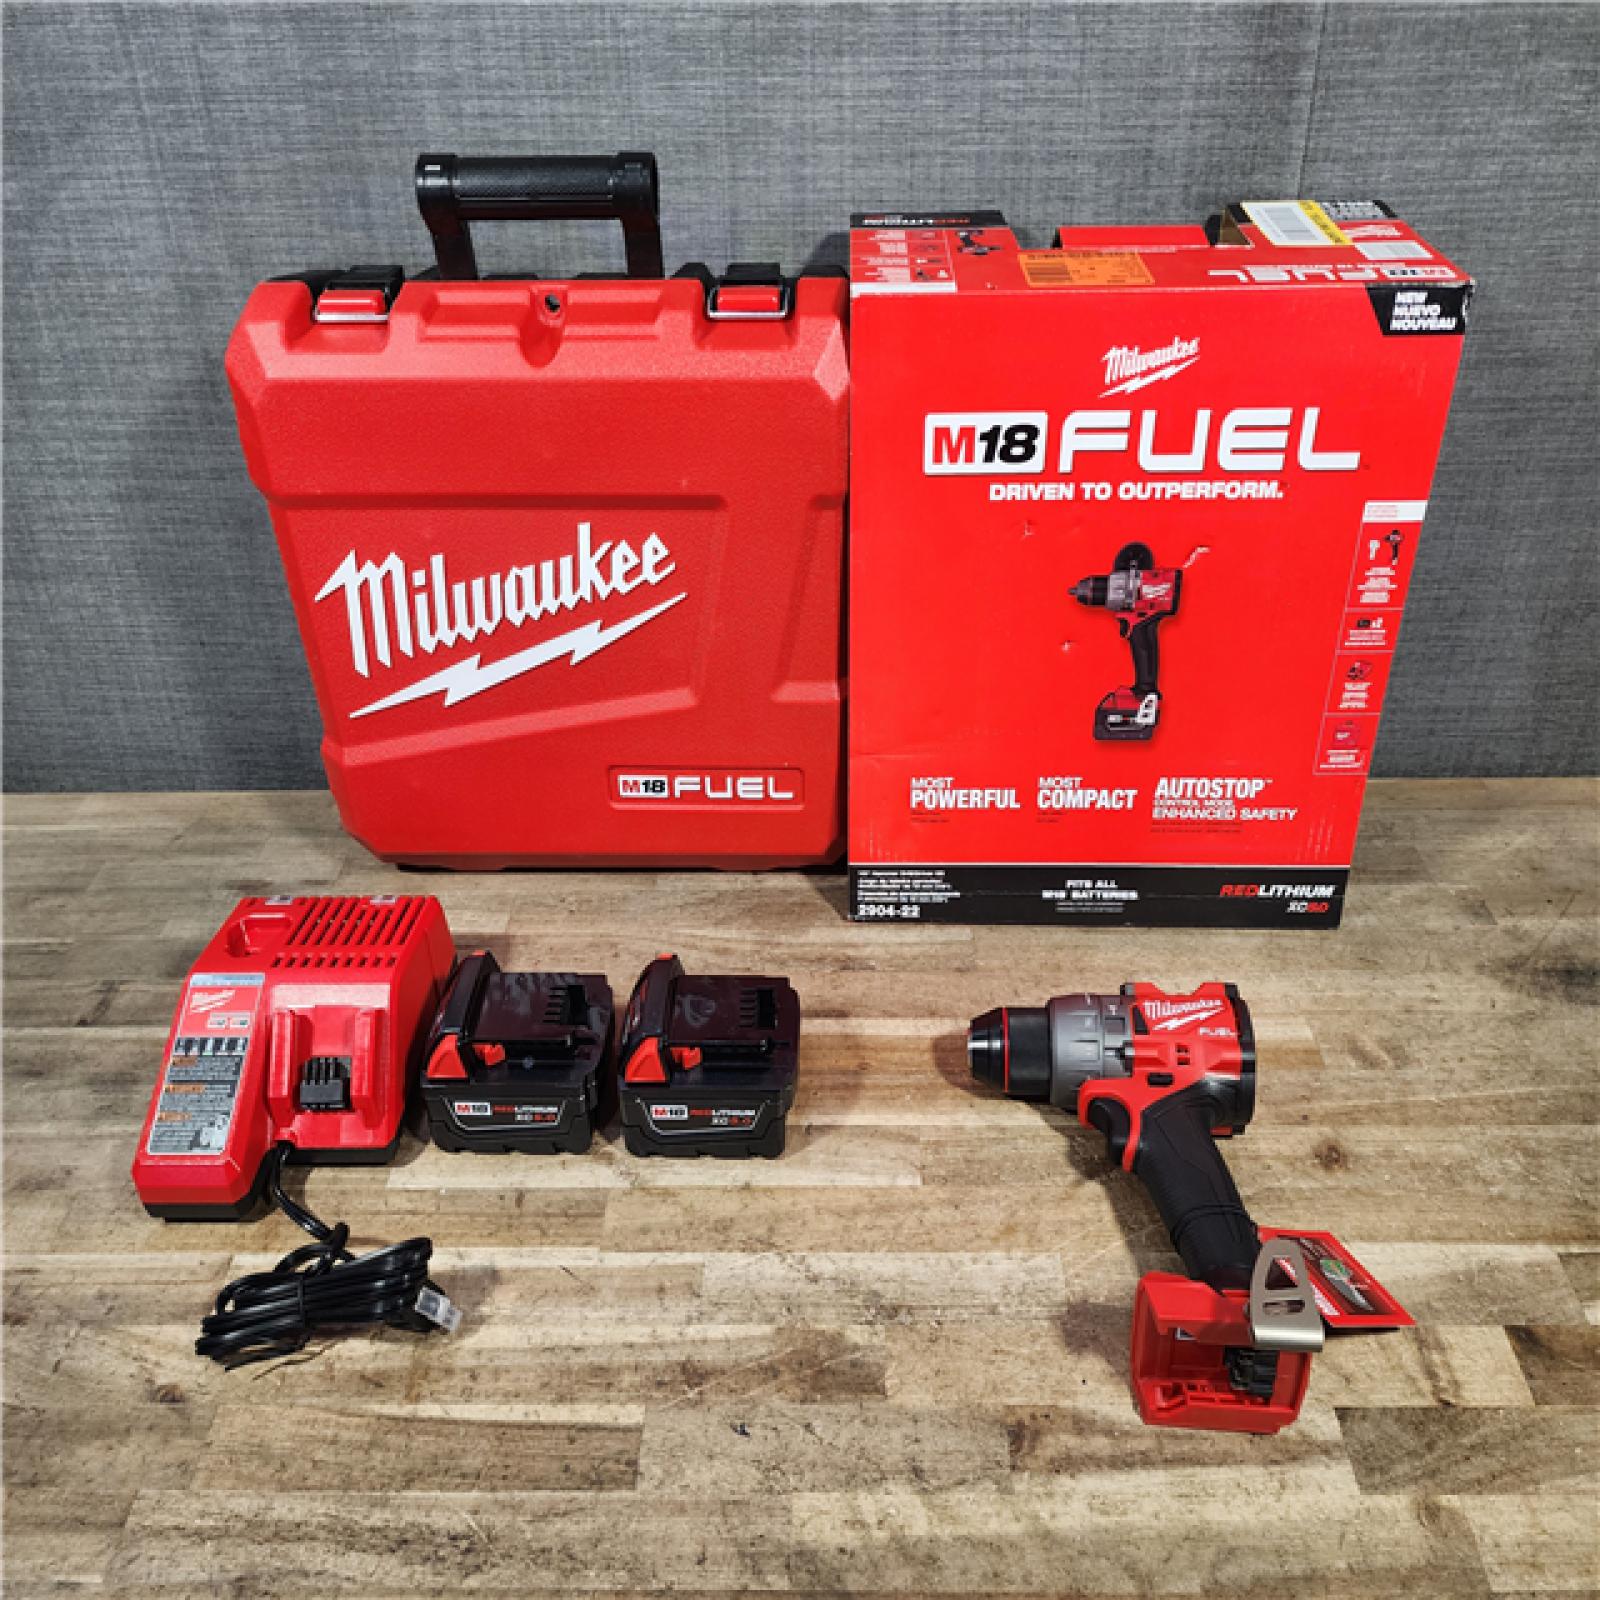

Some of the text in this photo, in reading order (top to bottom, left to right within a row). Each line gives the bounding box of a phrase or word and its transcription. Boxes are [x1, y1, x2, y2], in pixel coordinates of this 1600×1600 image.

[1101, 335, 1200, 386] Milwaukee
[930, 407, 1361, 474] M18 FUEL
[990, 480, 1284, 501] DRIVEN TO OUTPERFORM.
[314, 521, 676, 679] Milwaukee
[621, 775, 794, 799] M18 FUEL
[910, 776, 955, 789] MOST
[1038, 776, 1083, 789] MOST
[910, 789, 1021, 810] POWERFUL
[1037, 789, 1138, 810] COMPACT
[1152, 807, 1298, 821] ENHANCED SAFETY
[1141, 999, 1224, 1021] Milwaukee
